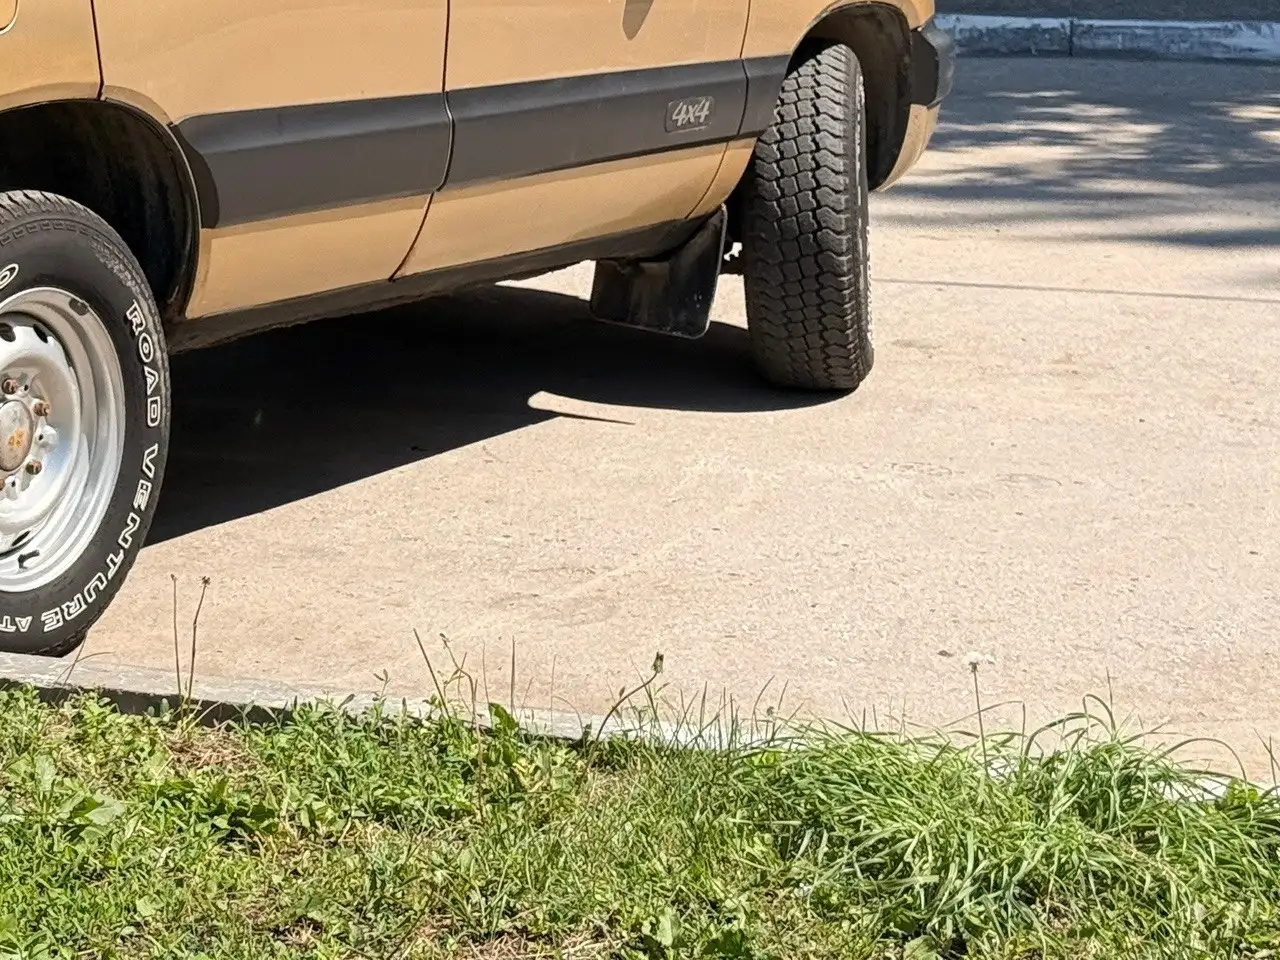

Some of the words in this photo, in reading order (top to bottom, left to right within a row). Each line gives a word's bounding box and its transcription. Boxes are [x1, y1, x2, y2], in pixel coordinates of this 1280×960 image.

[672, 97, 711, 127] 4x4
[125, 298, 161, 428] ROAD
[40, 442, 159, 633] VENTURE
